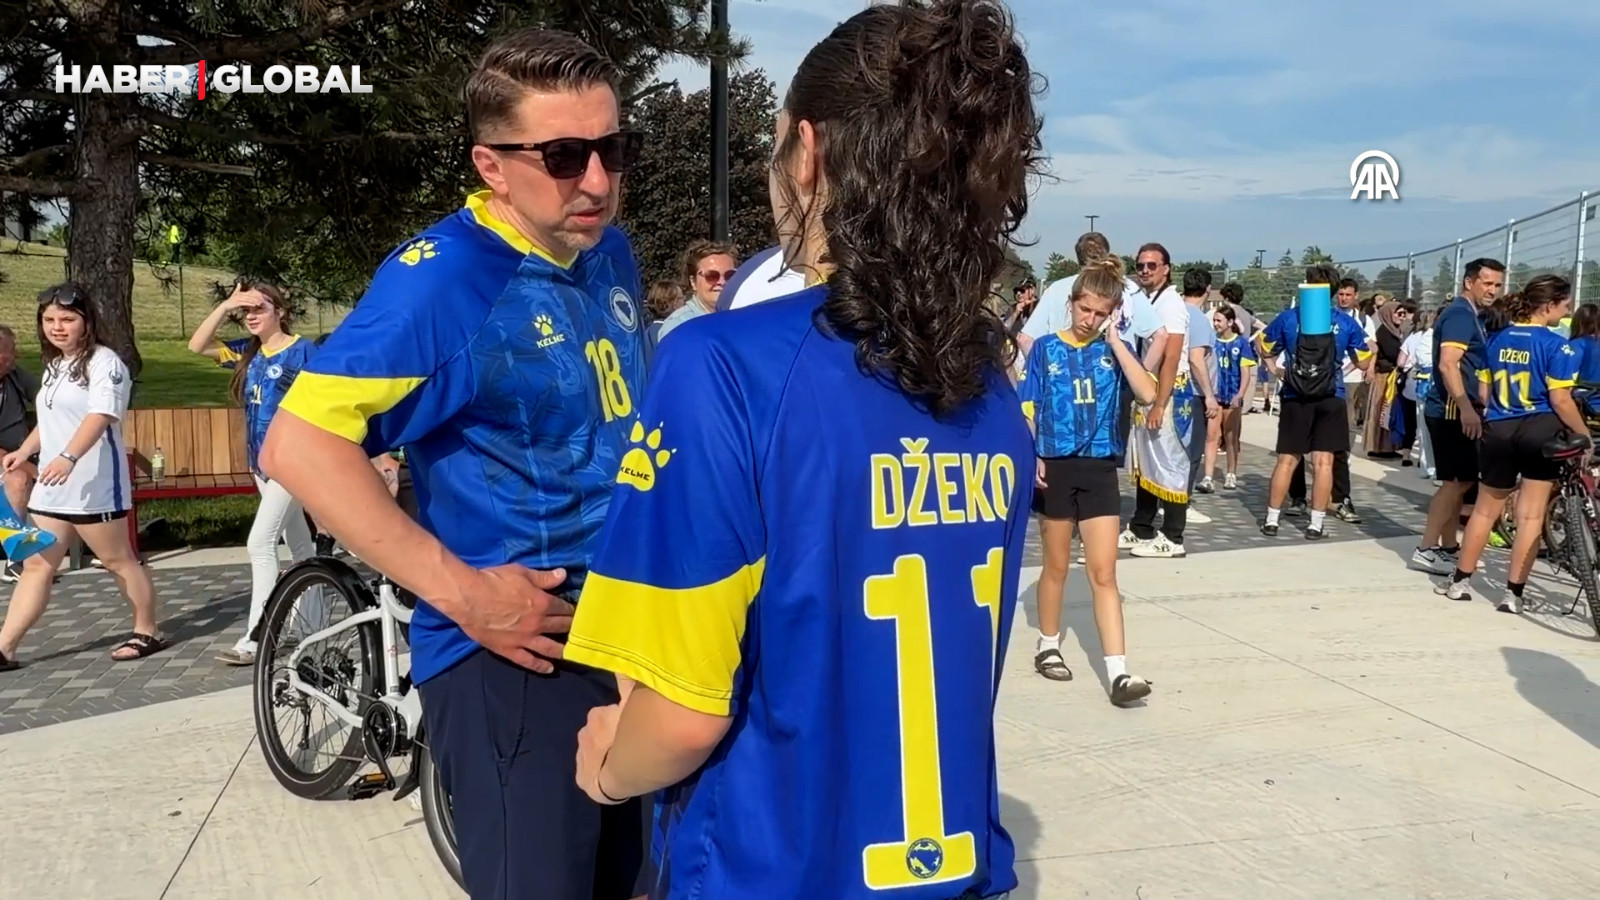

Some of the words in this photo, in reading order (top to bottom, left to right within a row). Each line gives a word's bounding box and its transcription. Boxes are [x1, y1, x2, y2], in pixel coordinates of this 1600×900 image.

[536, 334, 566, 348] KELME
[1219, 356, 1230, 368] 19
[1499, 348, 1530, 364] DŽEKO
[585, 338, 632, 422] 18
[1072, 378, 1096, 404] 11
[1493, 370, 1533, 410] 11
[870, 437, 1015, 530] DŽEKO
